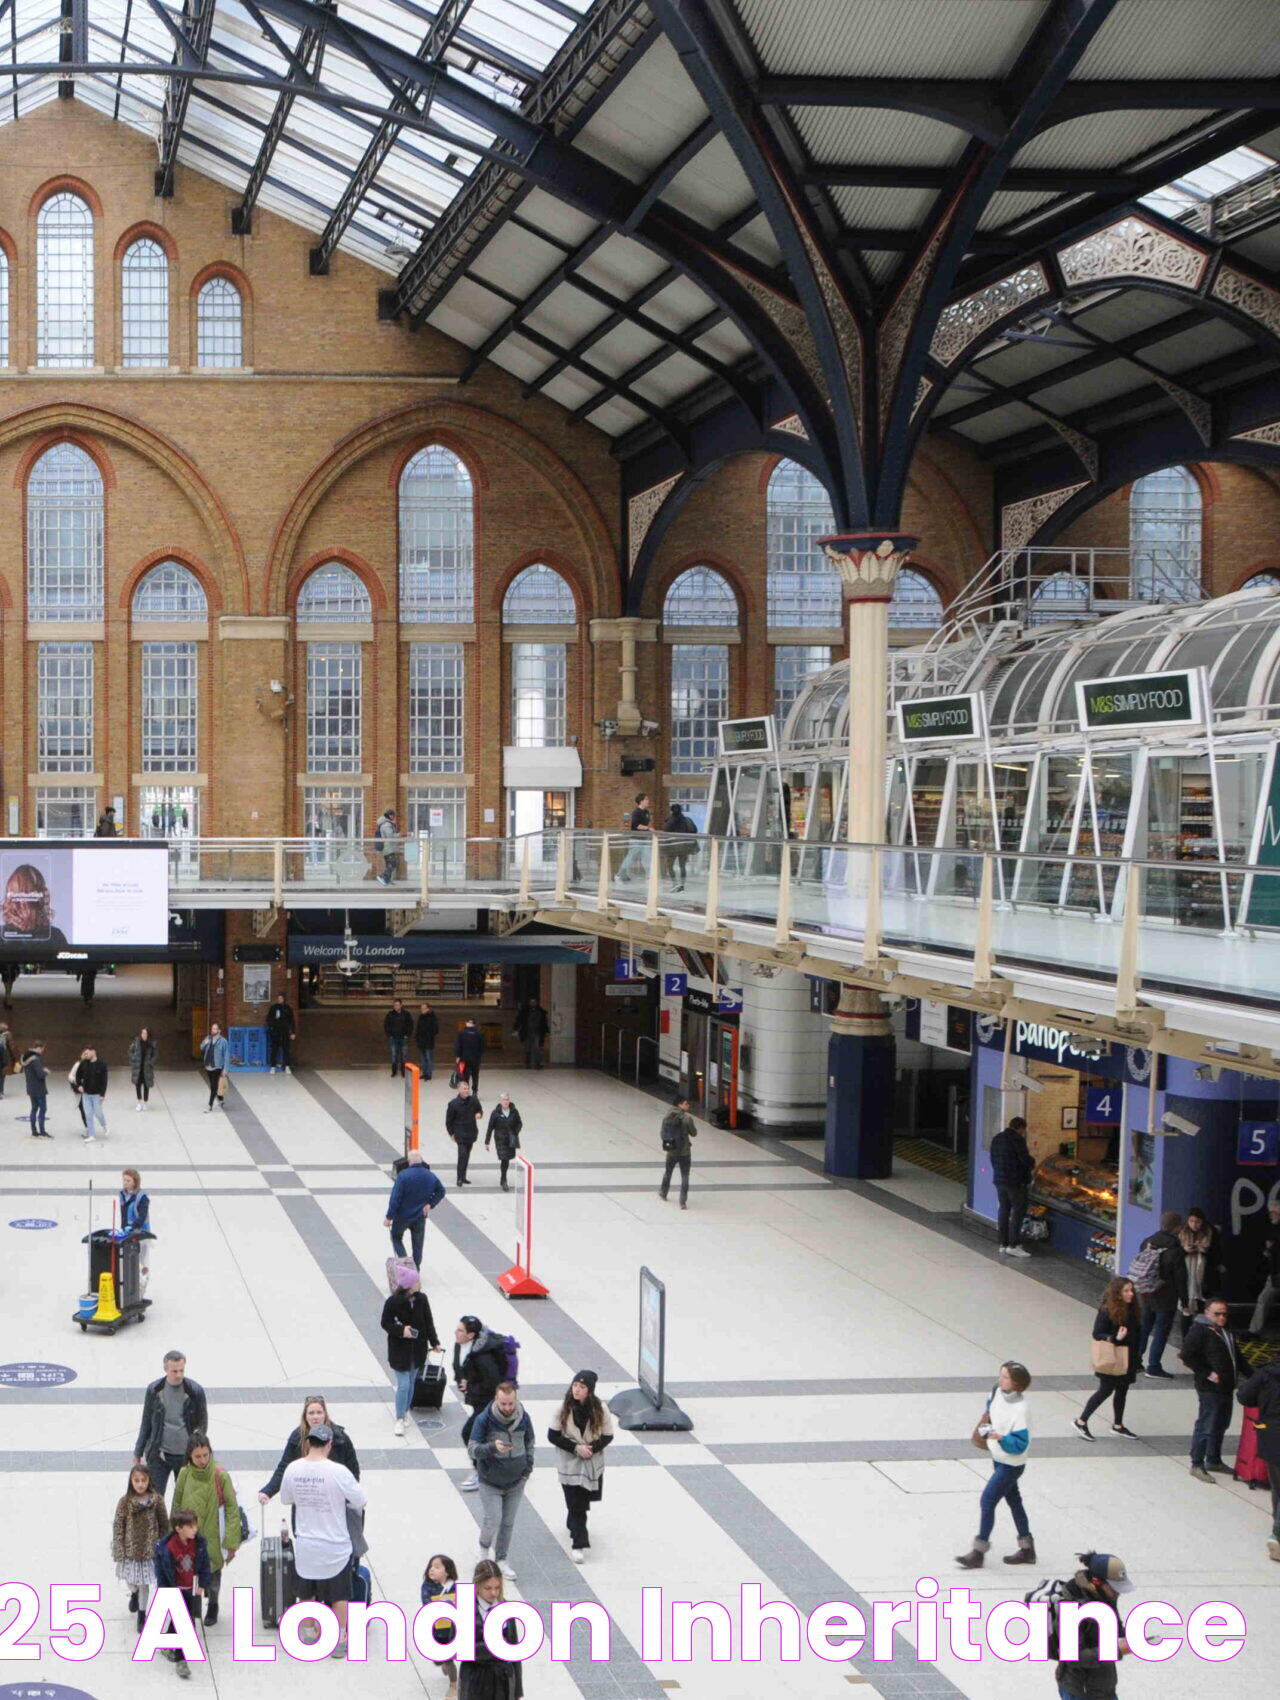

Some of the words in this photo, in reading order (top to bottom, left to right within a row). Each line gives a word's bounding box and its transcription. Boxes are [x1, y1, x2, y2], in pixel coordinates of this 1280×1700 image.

[1113, 692, 1149, 712] SIMPLY
[1149, 689, 1183, 708] FOOD
[945, 708, 969, 725] FOOD
[352, 947, 363, 956] to
[365, 944, 405, 956] London
[622, 962, 629, 976] 1
[671, 977, 681, 992] 2
[1016, 1020, 1101, 1063] panop
[1096, 1094, 1112, 1117] 4
[1250, 1129, 1266, 1155] 5
